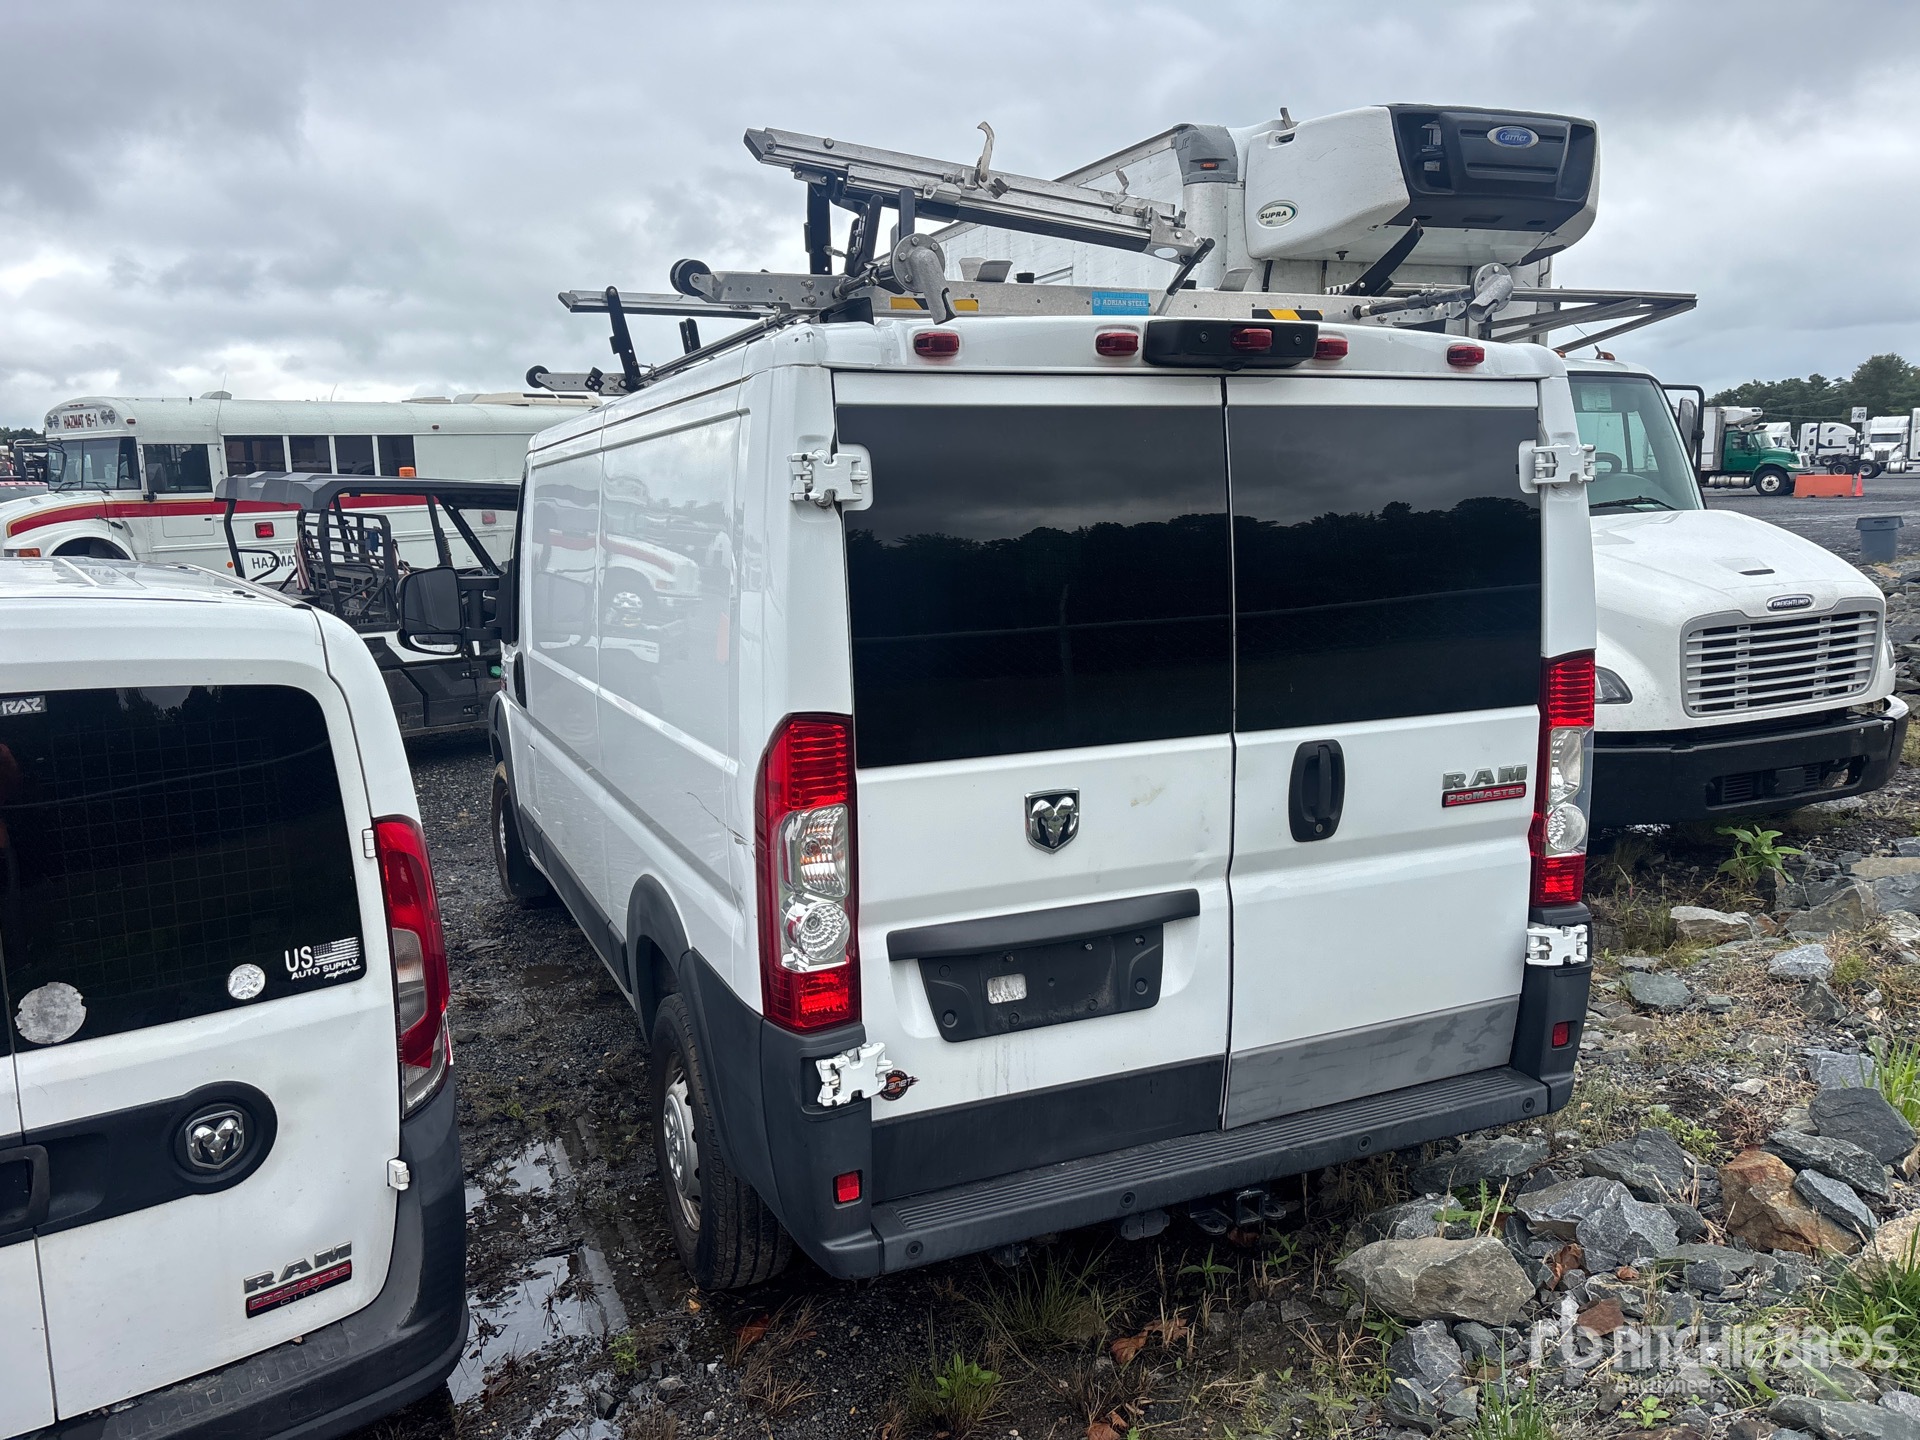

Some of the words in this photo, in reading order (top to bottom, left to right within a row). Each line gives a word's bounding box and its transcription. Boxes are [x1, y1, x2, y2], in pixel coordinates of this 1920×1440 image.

[1500, 132, 1528, 142] Carrier
[1260, 210, 1287, 220] SUPRA
[1103, 299, 1127, 307] ADRIAN
[63, 414, 84, 429] HAZMAT
[252, 555, 296, 570] HAZMA
[1773, 598, 1809, 608] FREIGHTLINER
[1442, 763, 1529, 791] RAM
[1447, 787, 1524, 803] PROMASTER
[285, 945, 314, 972] US
[291, 967, 321, 980] AUTO
[322, 958, 358, 973] SUPPLY
[243, 1240, 352, 1294] RAM
[251, 1265, 348, 1308] PROMASTER
[280, 1285, 321, 1305] CITY
